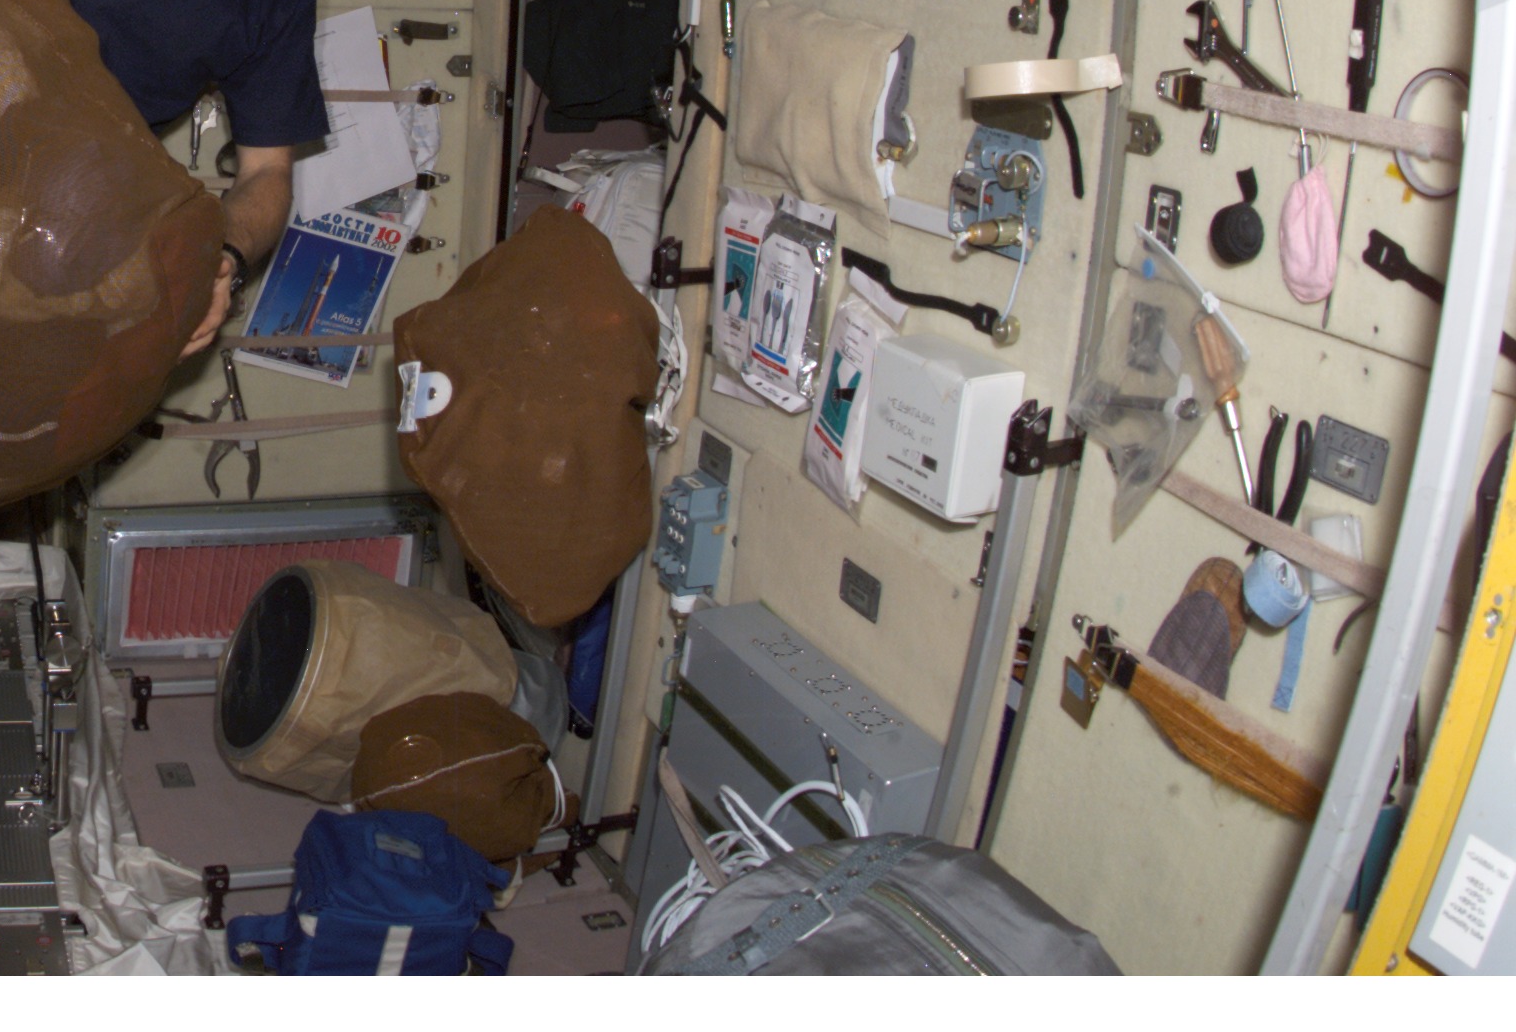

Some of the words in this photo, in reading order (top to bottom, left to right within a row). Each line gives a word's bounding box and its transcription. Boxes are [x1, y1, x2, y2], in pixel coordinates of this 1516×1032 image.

[375, 226, 402, 245] 10
[370, 238, 397, 253] 2002
[329, 312, 355, 325] Atlas
[355, 318, 362, 327] 5
